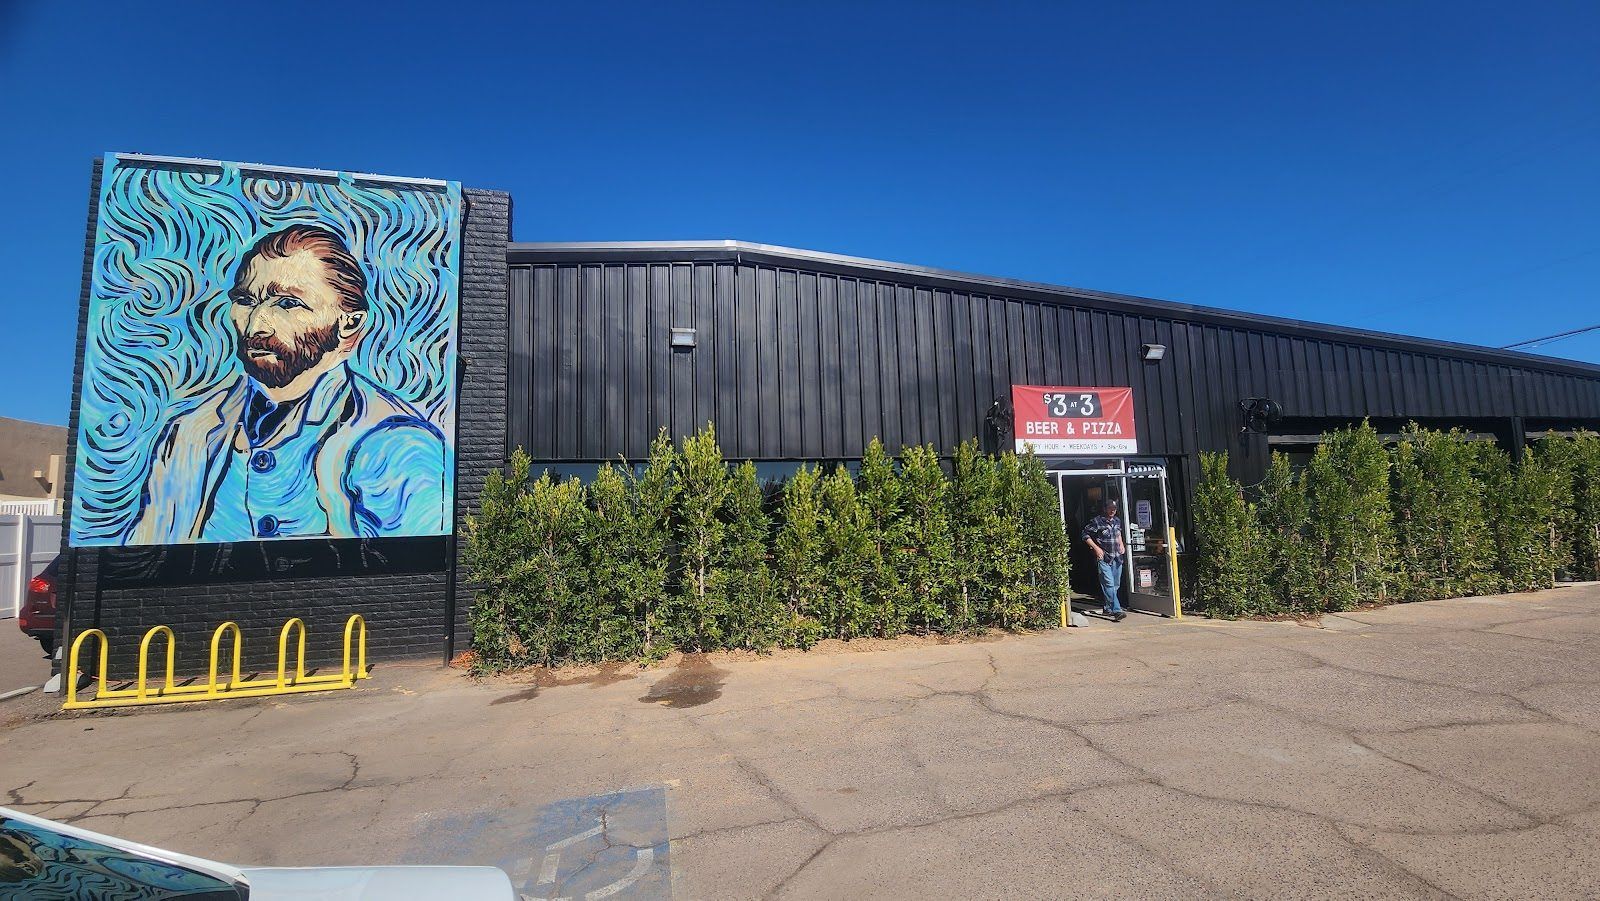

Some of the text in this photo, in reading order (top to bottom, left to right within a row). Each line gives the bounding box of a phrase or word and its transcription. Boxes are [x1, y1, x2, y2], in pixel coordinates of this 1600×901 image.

[1043, 393, 1067, 416] $3
[1080, 394, 1094, 416] 3
[1026, 421, 1122, 435] BEER & PIZZA
